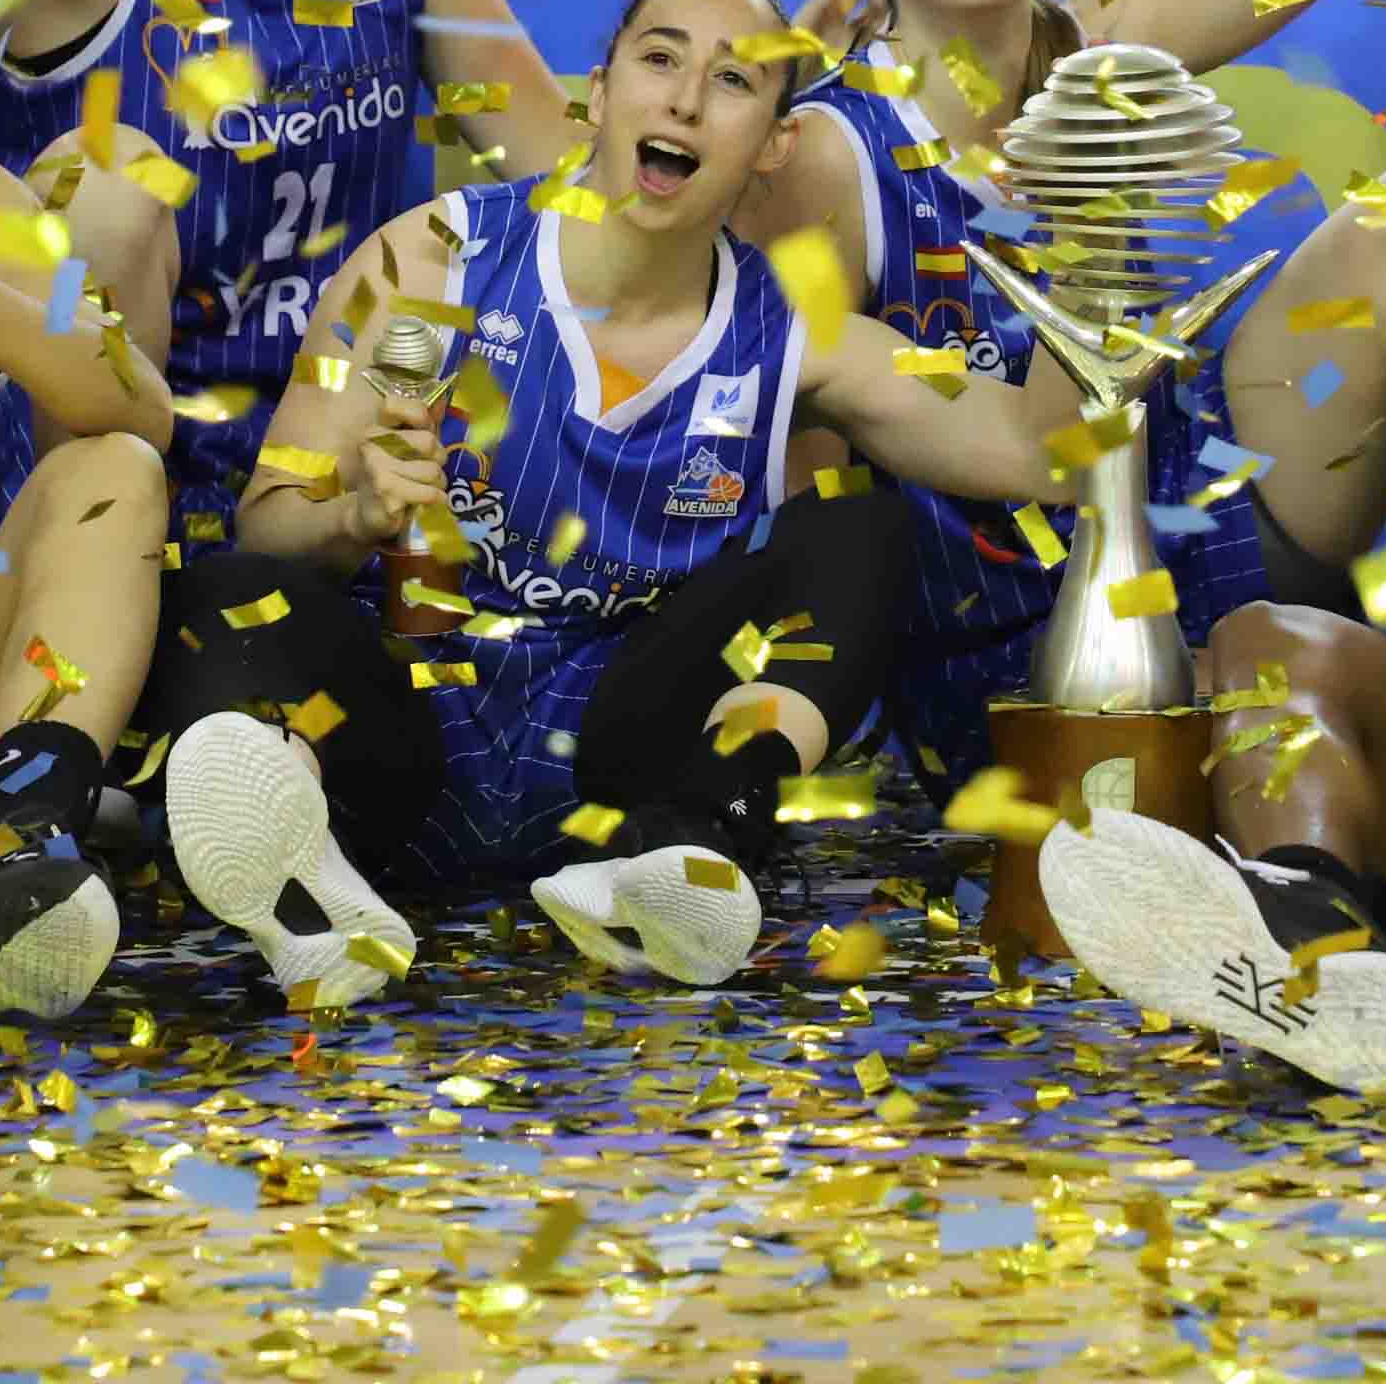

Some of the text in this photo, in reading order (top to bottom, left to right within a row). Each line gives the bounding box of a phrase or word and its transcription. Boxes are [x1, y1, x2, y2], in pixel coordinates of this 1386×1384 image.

[212, 76, 405, 150] avenida
[262, 162, 336, 261] 21
[215, 276, 332, 338] YR
[668, 500, 736, 515] AVENIDA
